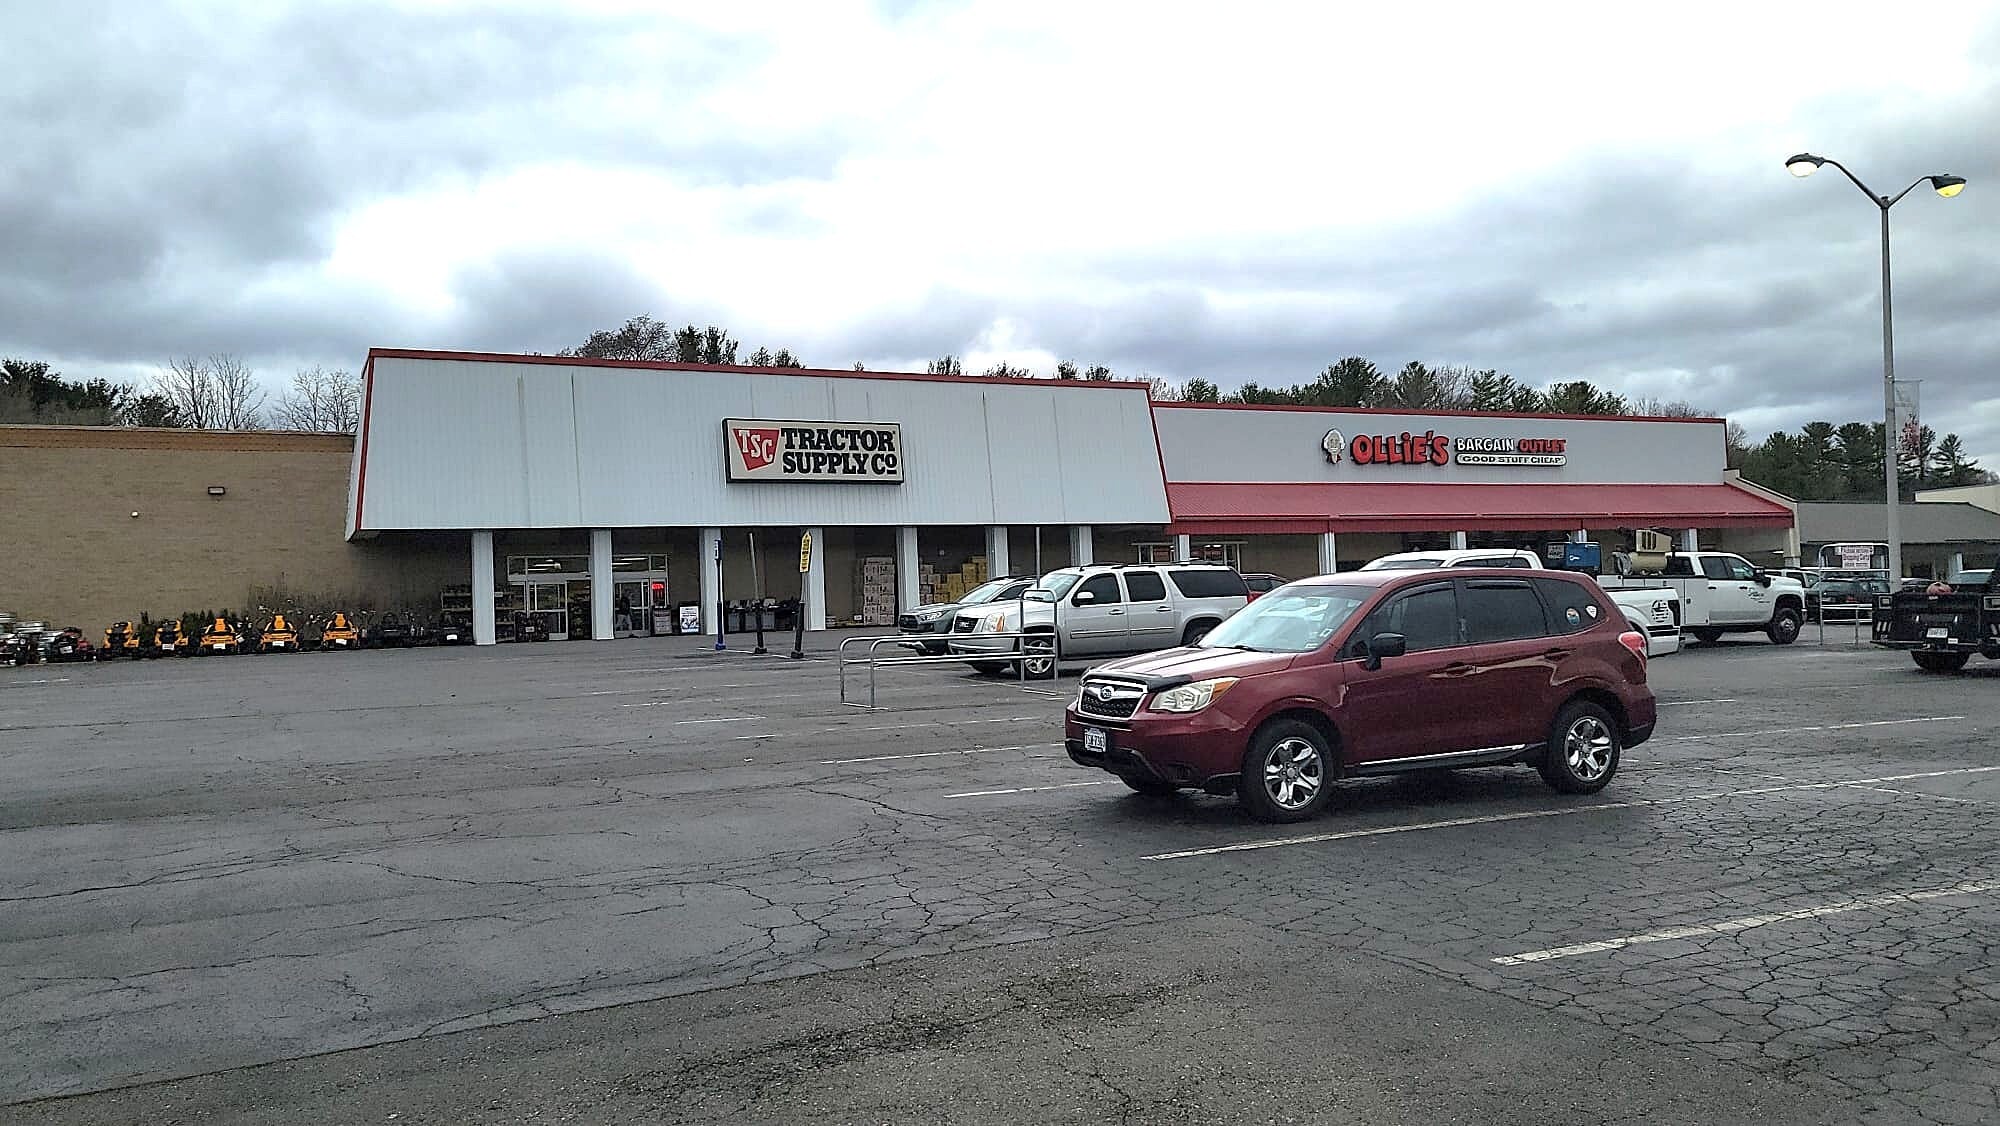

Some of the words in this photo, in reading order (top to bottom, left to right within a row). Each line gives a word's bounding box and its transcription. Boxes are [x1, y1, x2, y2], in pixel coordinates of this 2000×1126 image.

[739, 430, 772, 463] TSC
[781, 427, 896, 451] TRACTOR
[1456, 438, 1515, 452] BARGAIN
[1518, 438, 1567, 453] OUTLET
[782, 452, 869, 474] SUPPLY
[1498, 456, 1530, 464] STUFF
